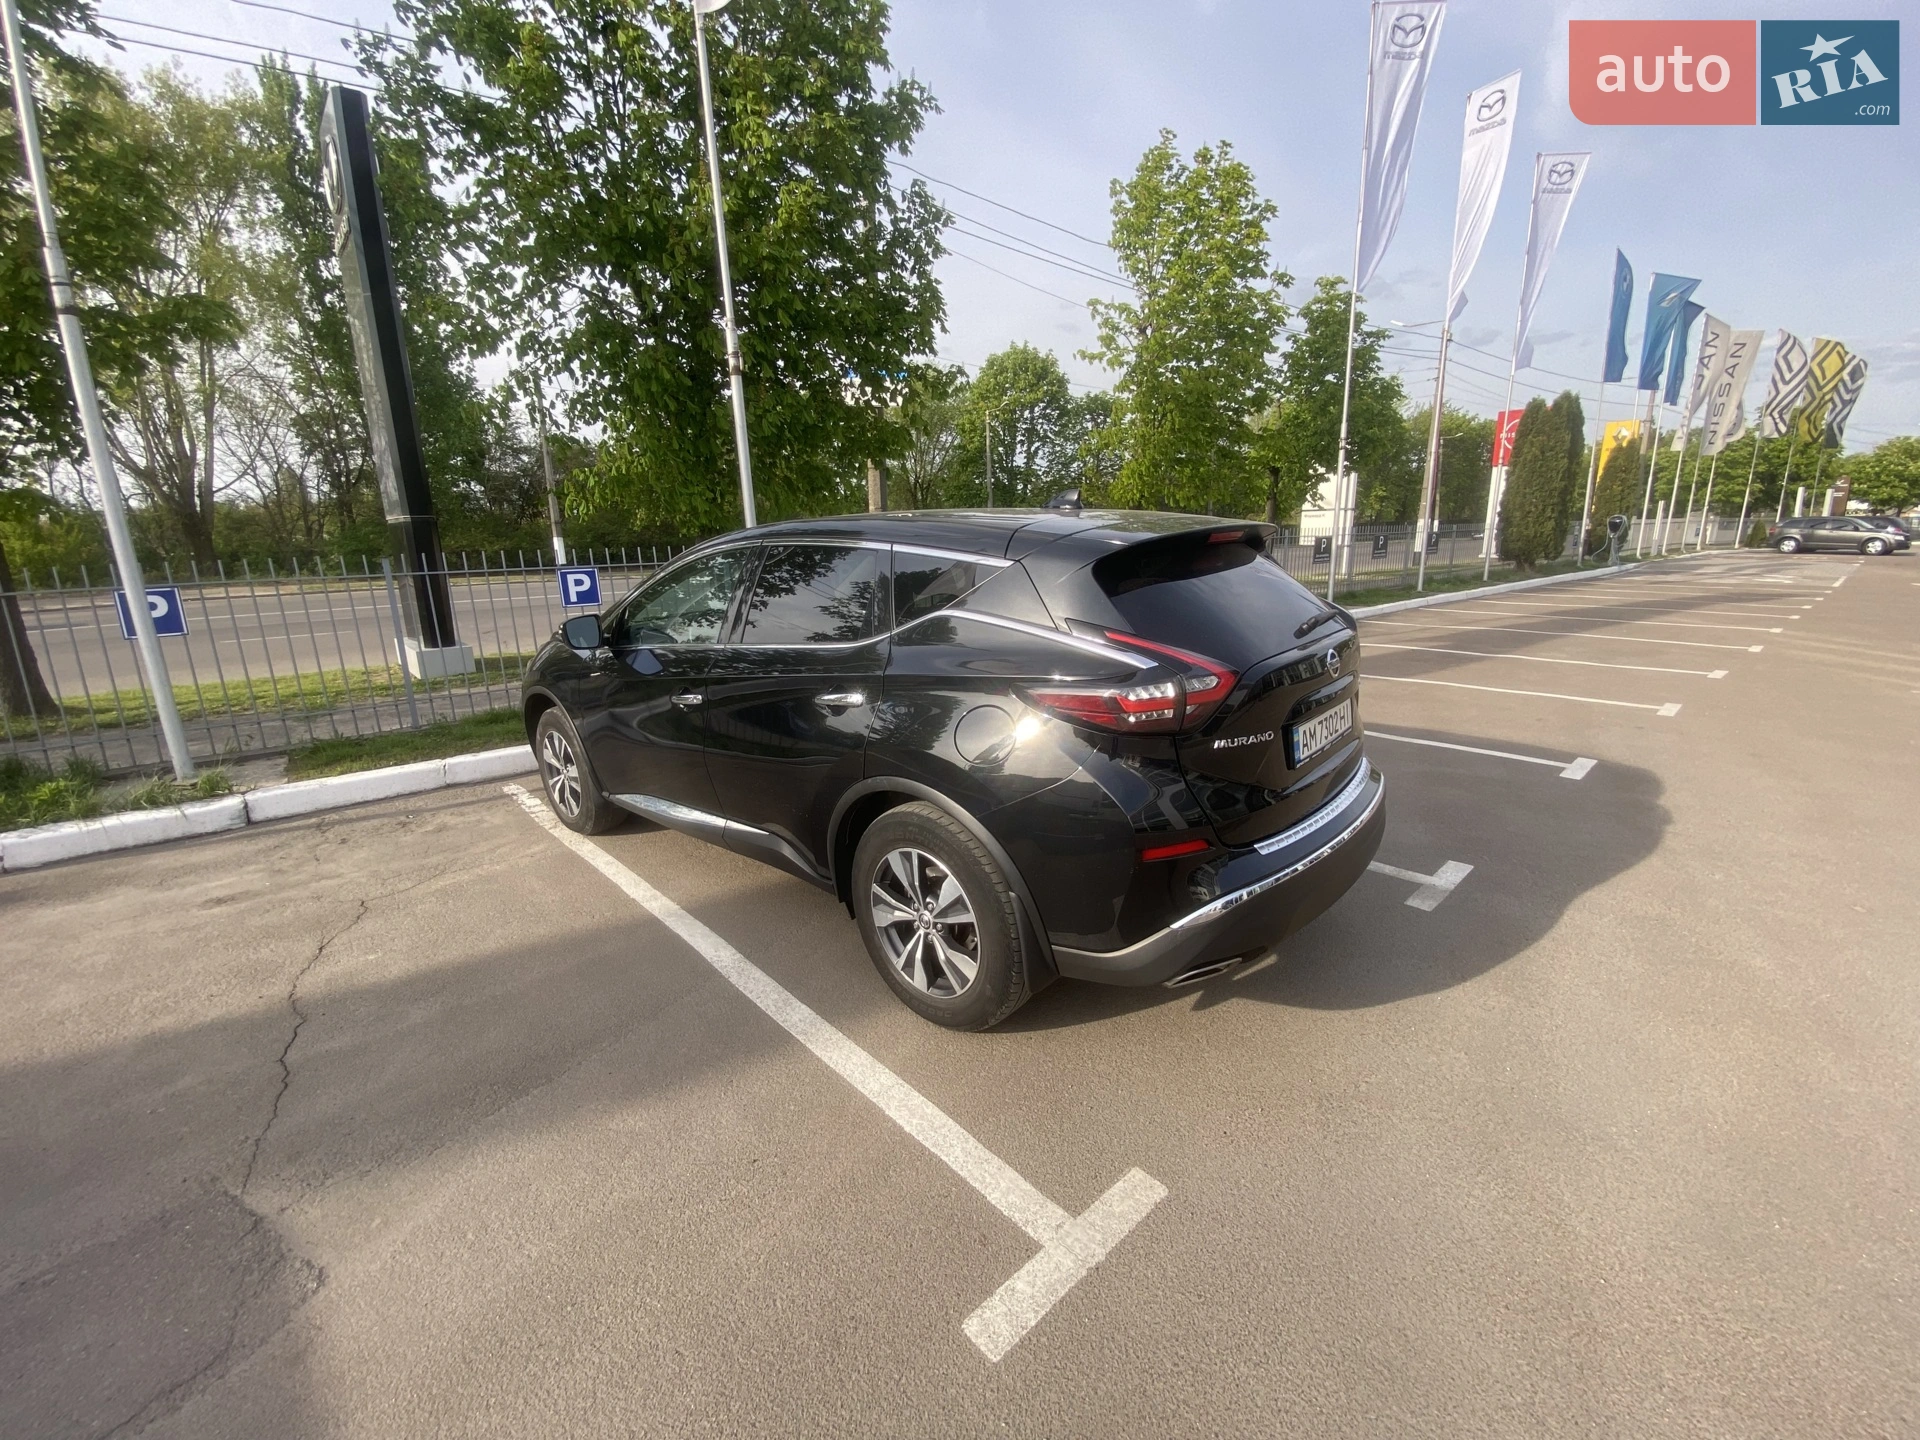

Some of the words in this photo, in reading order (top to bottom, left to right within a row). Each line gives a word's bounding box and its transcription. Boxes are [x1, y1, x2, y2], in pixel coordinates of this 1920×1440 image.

[1708, 342, 1747, 445] NISSAN
[566, 573, 591, 603] P
[1213, 730, 1274, 749] MURANO
